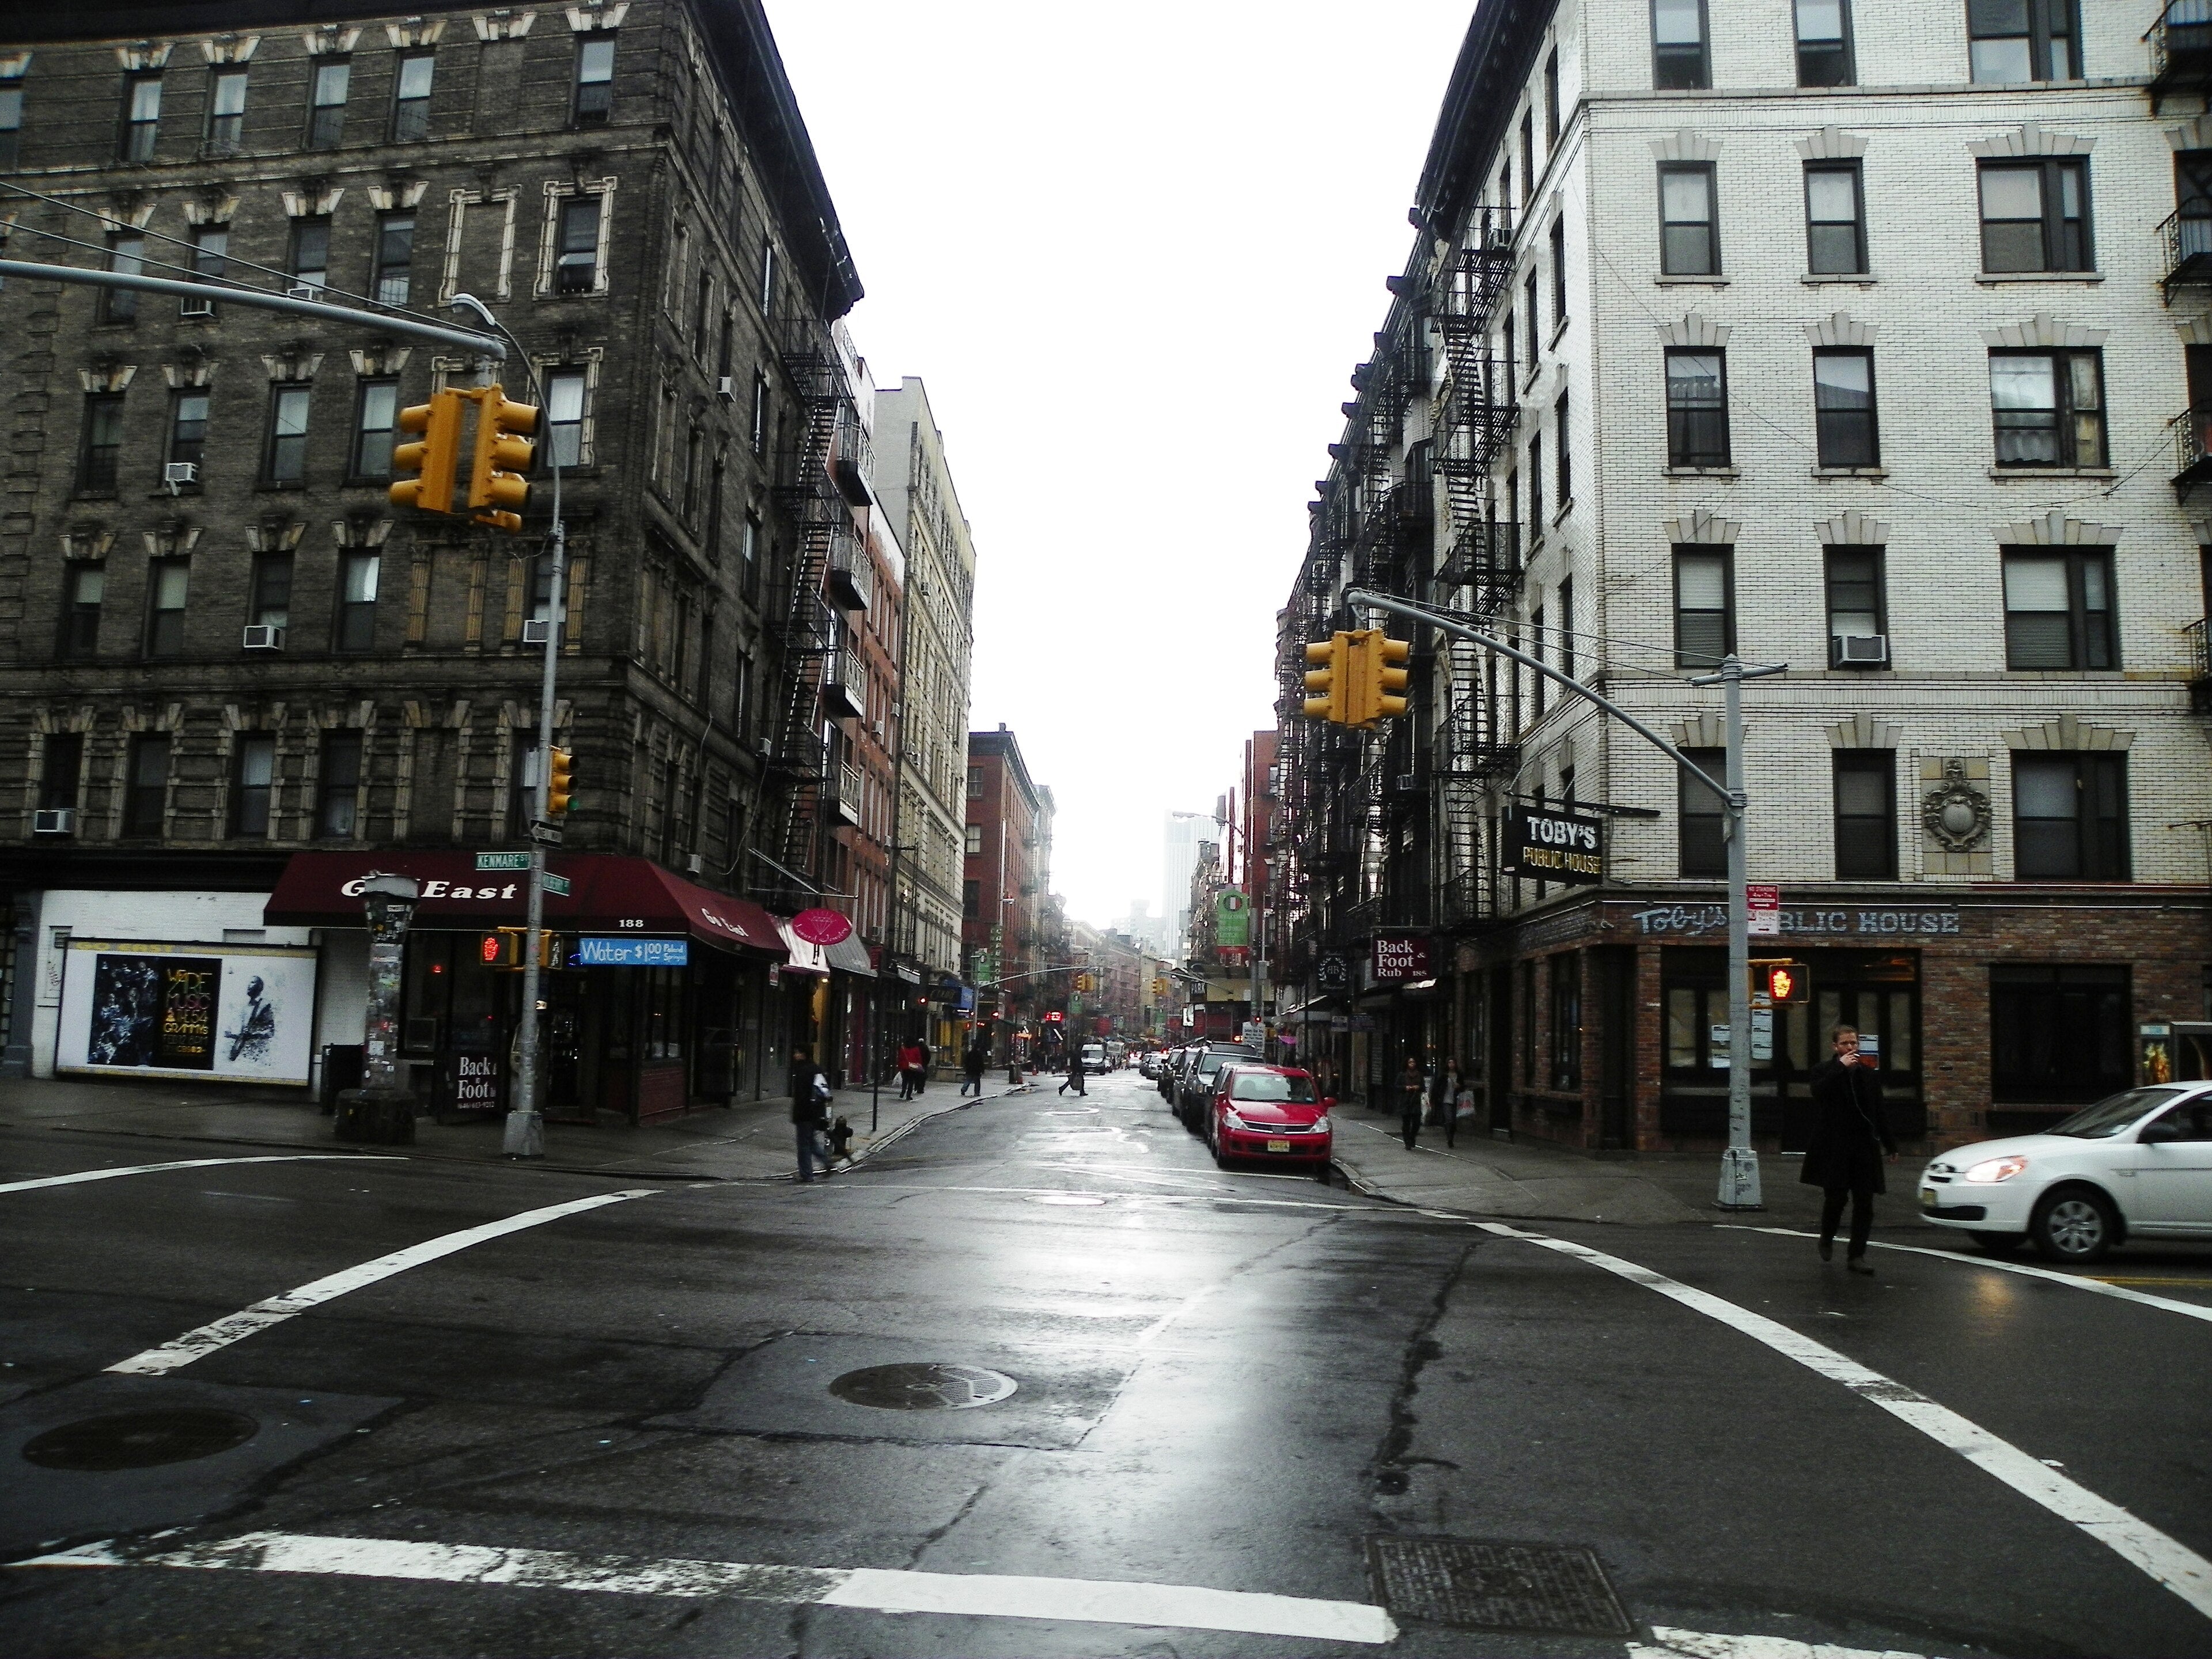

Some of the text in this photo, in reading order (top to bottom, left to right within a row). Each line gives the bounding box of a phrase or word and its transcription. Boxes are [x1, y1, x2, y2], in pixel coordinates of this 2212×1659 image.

[1527, 816, 1598, 849] TOBY'S
[477, 854, 519, 868] KENMARE
[1523, 846, 1601, 874] PUBLIC HOUSE
[421, 881, 517, 899] East
[619, 919, 644, 927] 188
[1631, 906, 1959, 935] Toby's BLIC HOUSE
[581, 941, 633, 961] Water
[1377, 940, 1413, 953] Back
[1377, 954, 1414, 967] Foot
[1377, 968, 1402, 977] Rub
[168, 972, 213, 995] ARE
[166, 993, 211, 1010] MUSIC
[459, 1056, 491, 1076] Back
[457, 1080, 488, 1099] Foot
